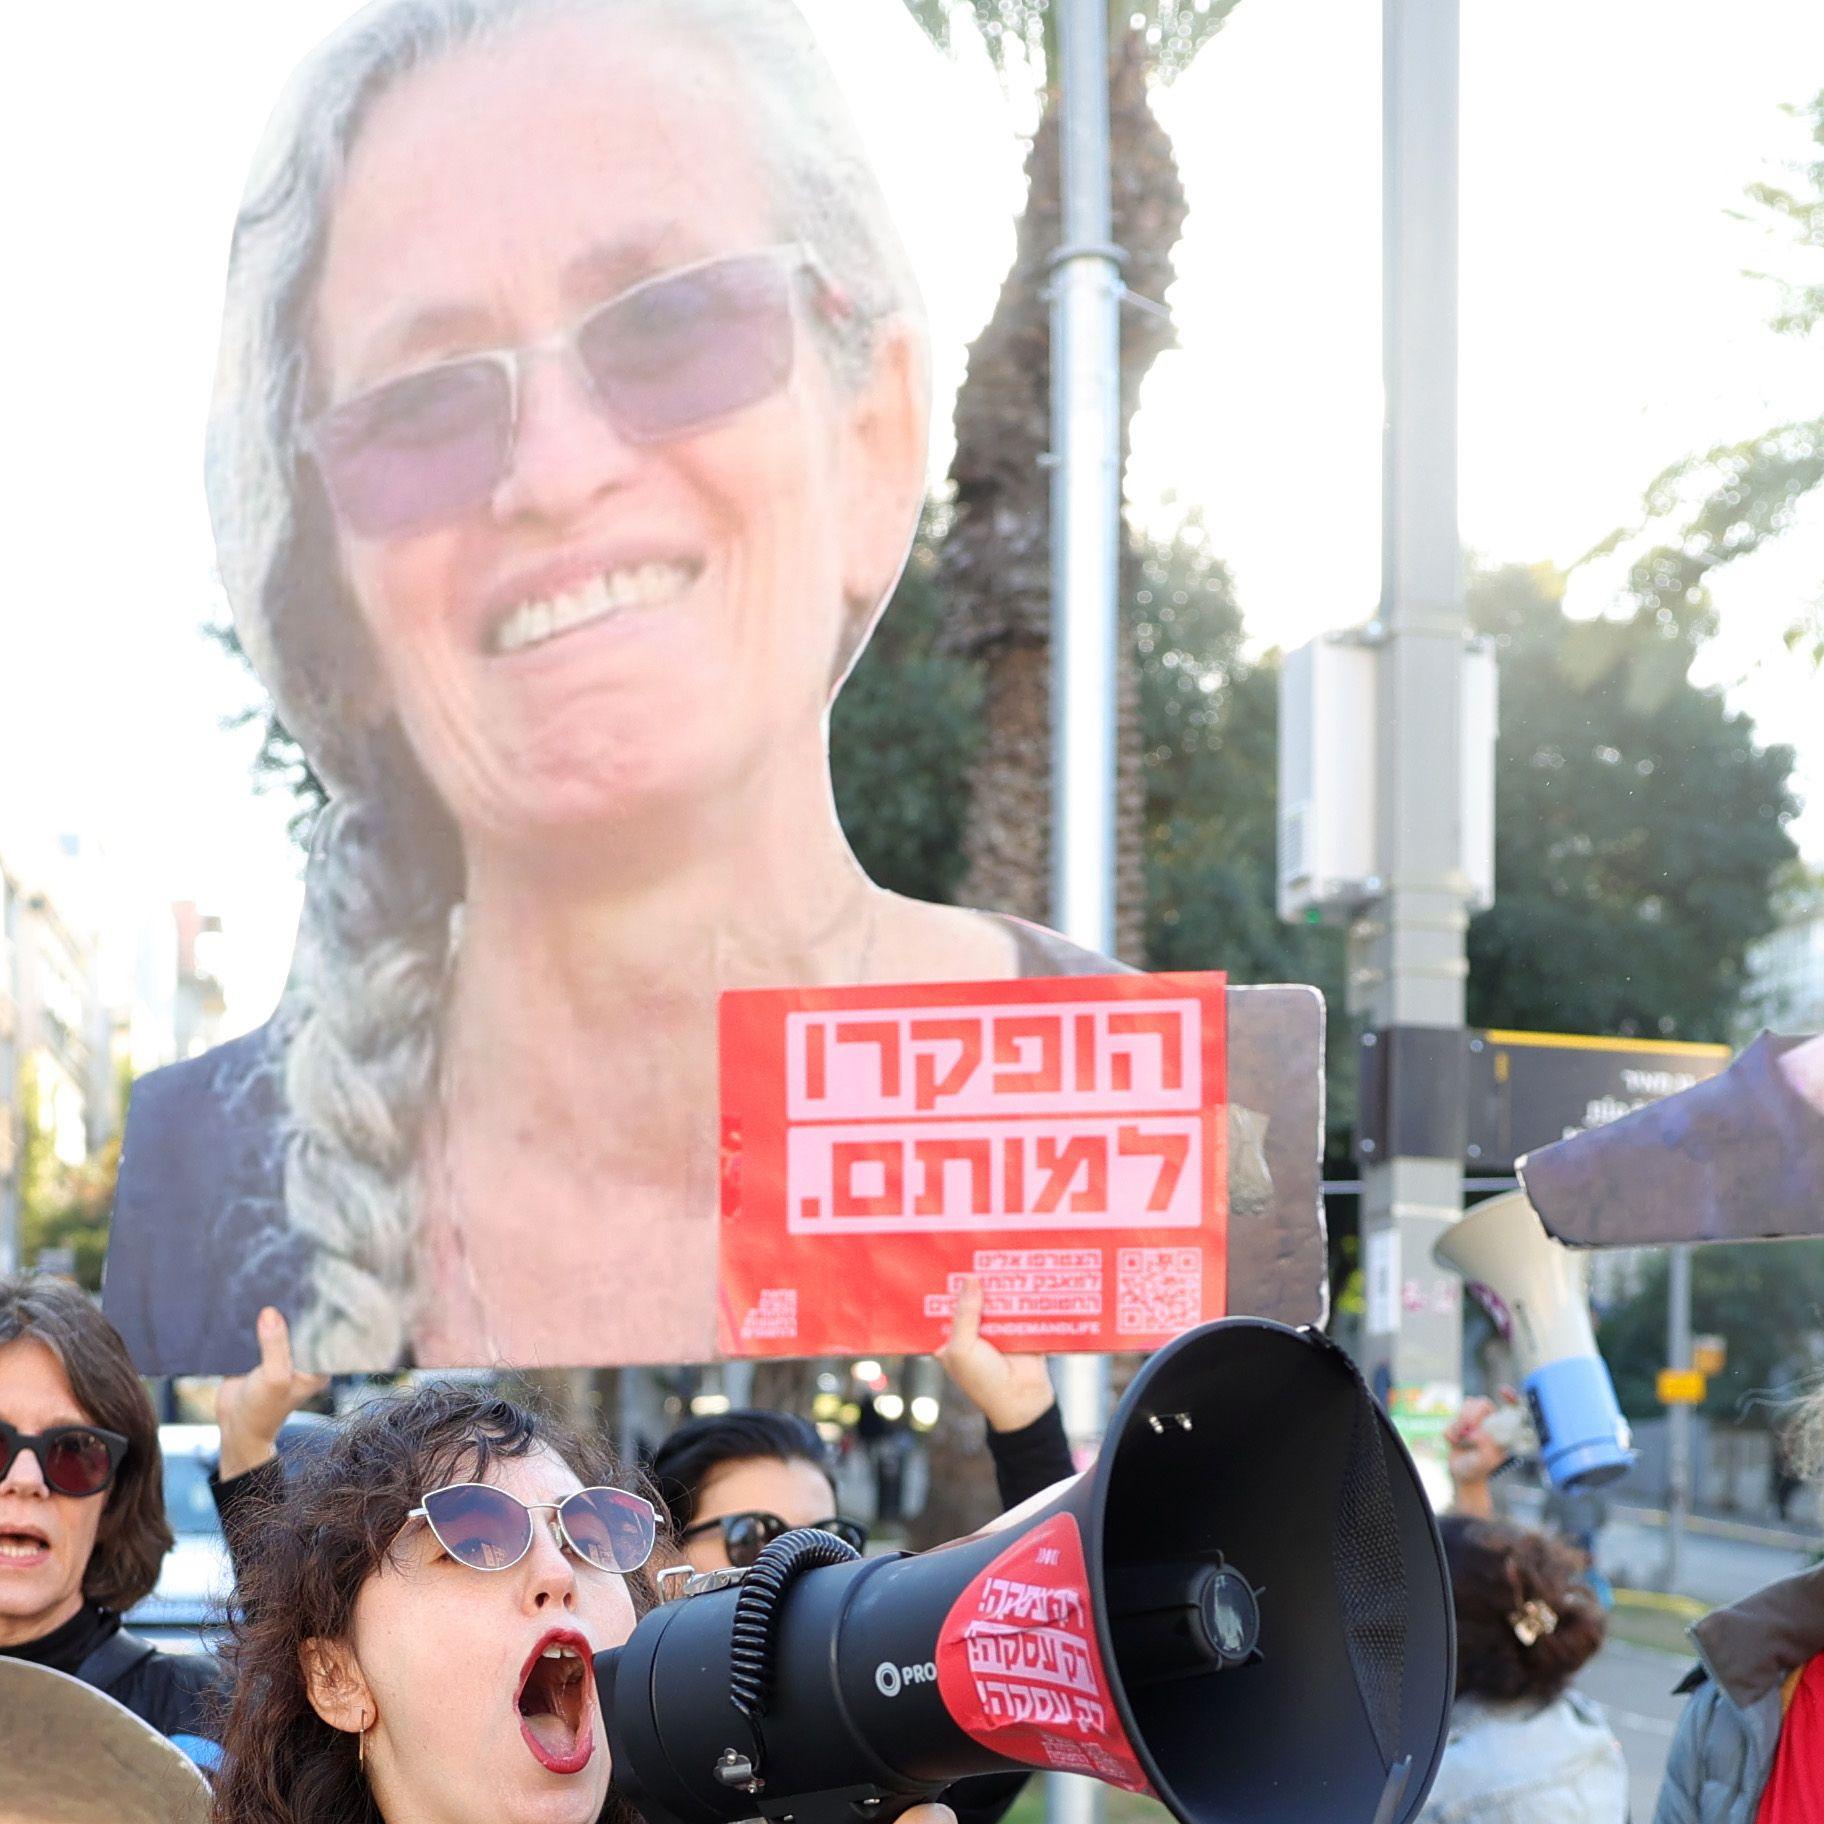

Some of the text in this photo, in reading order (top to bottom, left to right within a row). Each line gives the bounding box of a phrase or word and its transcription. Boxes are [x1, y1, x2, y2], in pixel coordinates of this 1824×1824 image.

[805, 1010, 1184, 1110] הופקרו
[800, 1126, 1192, 1219] למותם.
[976, 1680, 1073, 1724] עסקה!
